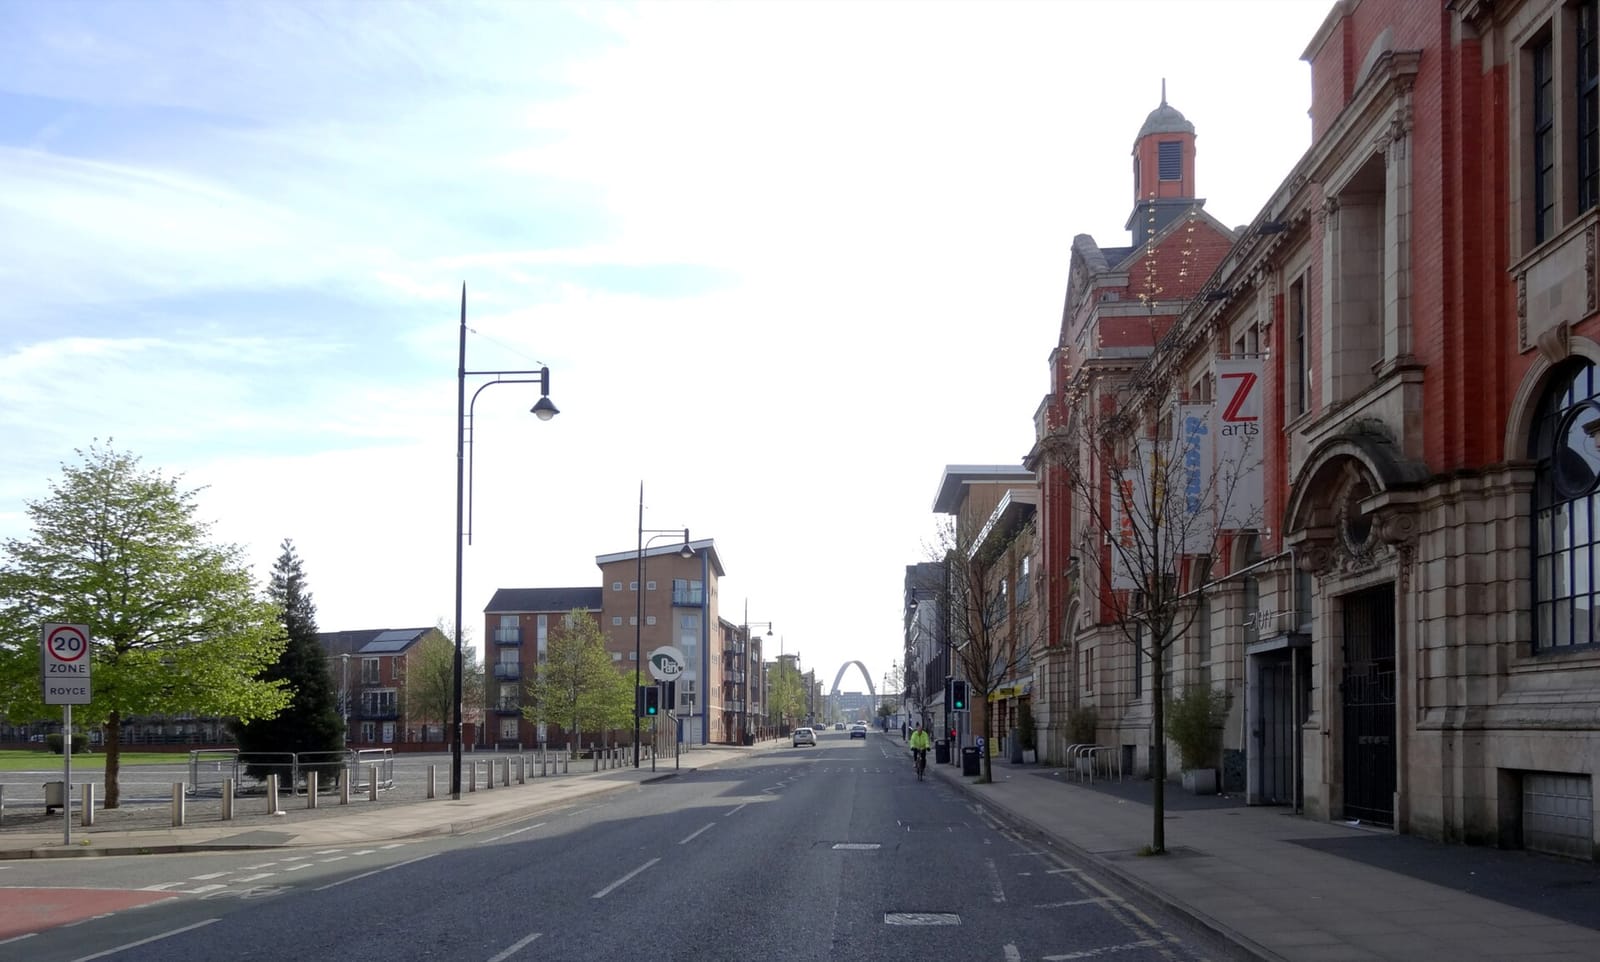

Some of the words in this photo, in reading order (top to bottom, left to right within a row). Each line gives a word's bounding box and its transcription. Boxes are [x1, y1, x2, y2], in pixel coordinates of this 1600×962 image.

[1221, 372, 1258, 422] Z
[1222, 421, 1259, 437] arts
[1185, 416, 1208, 513] drama
[54, 637, 80, 651] 20
[49, 664, 86, 673] ZONE
[661, 657, 680, 673] Park
[50, 687, 86, 695] ROYCE
